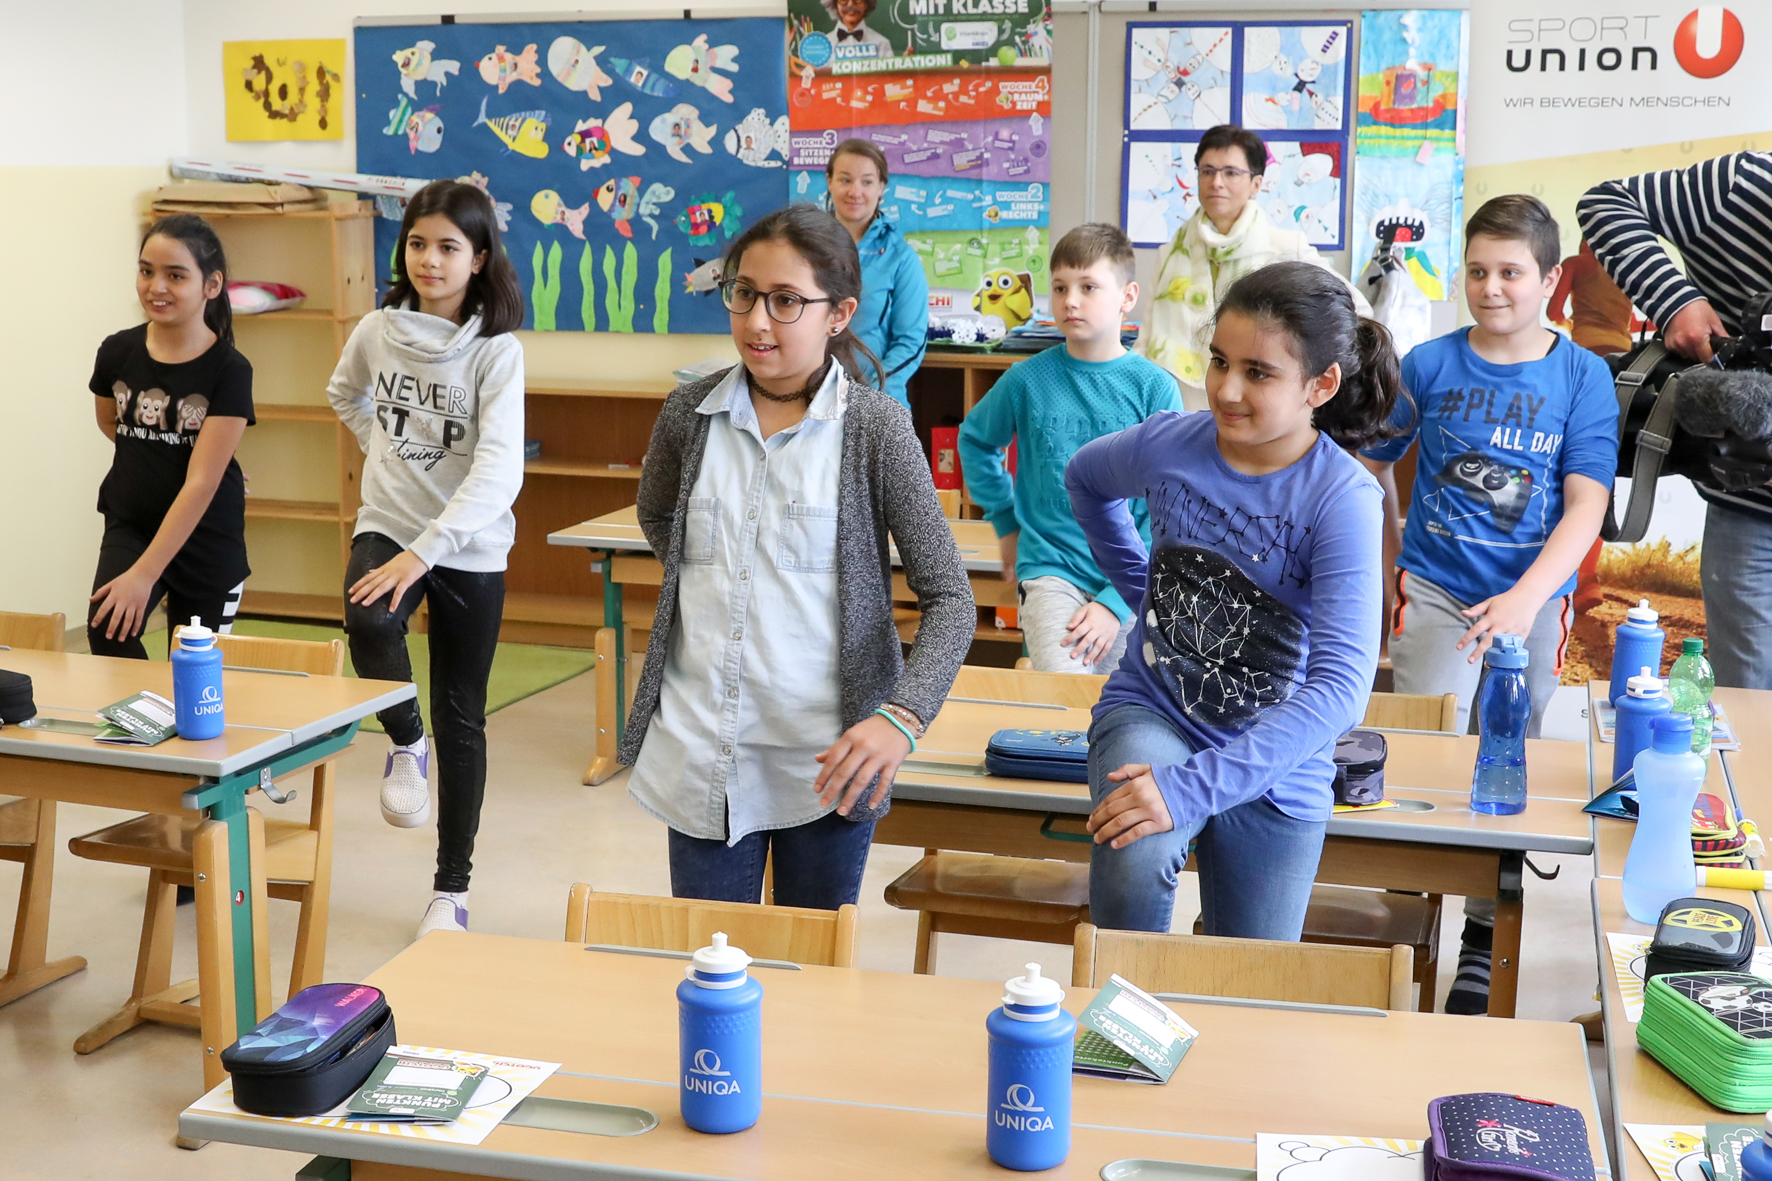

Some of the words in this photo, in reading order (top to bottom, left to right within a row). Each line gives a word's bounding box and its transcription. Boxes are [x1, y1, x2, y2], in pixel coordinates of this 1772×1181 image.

[909, 0, 945, 15] MIT
[952, 0, 1029, 14] KLASSE
[1507, 15, 1660, 44] SPORT
[836, 44, 876, 58] VOLLE
[832, 54, 951, 73] KONZENTRATION!
[1035, 77, 1047, 91] 4
[1016, 101, 1037, 110] ZEIT
[1503, 97, 1534, 108] WIR
[1540, 97, 1623, 108] BEWEGEN
[1630, 96, 1731, 107] MENSCHEN
[825, 132, 835, 146] 3
[1031, 185, 1041, 199] 2
[1001, 210, 1038, 219] RECHTS
[375, 371, 467, 415] NEVER
[1438, 387, 1547, 428] #PLAY
[1489, 426, 1524, 451] ALL
[1530, 431, 1564, 455] DAY
[684, 1076, 741, 1095] UNIQA
[371, 1092, 423, 1101] KLASSE
[375, 1098, 441, 1109] PUNKTEN
[424, 1096, 452, 1105] MIT
[995, 1111, 1054, 1132] UNIQA
